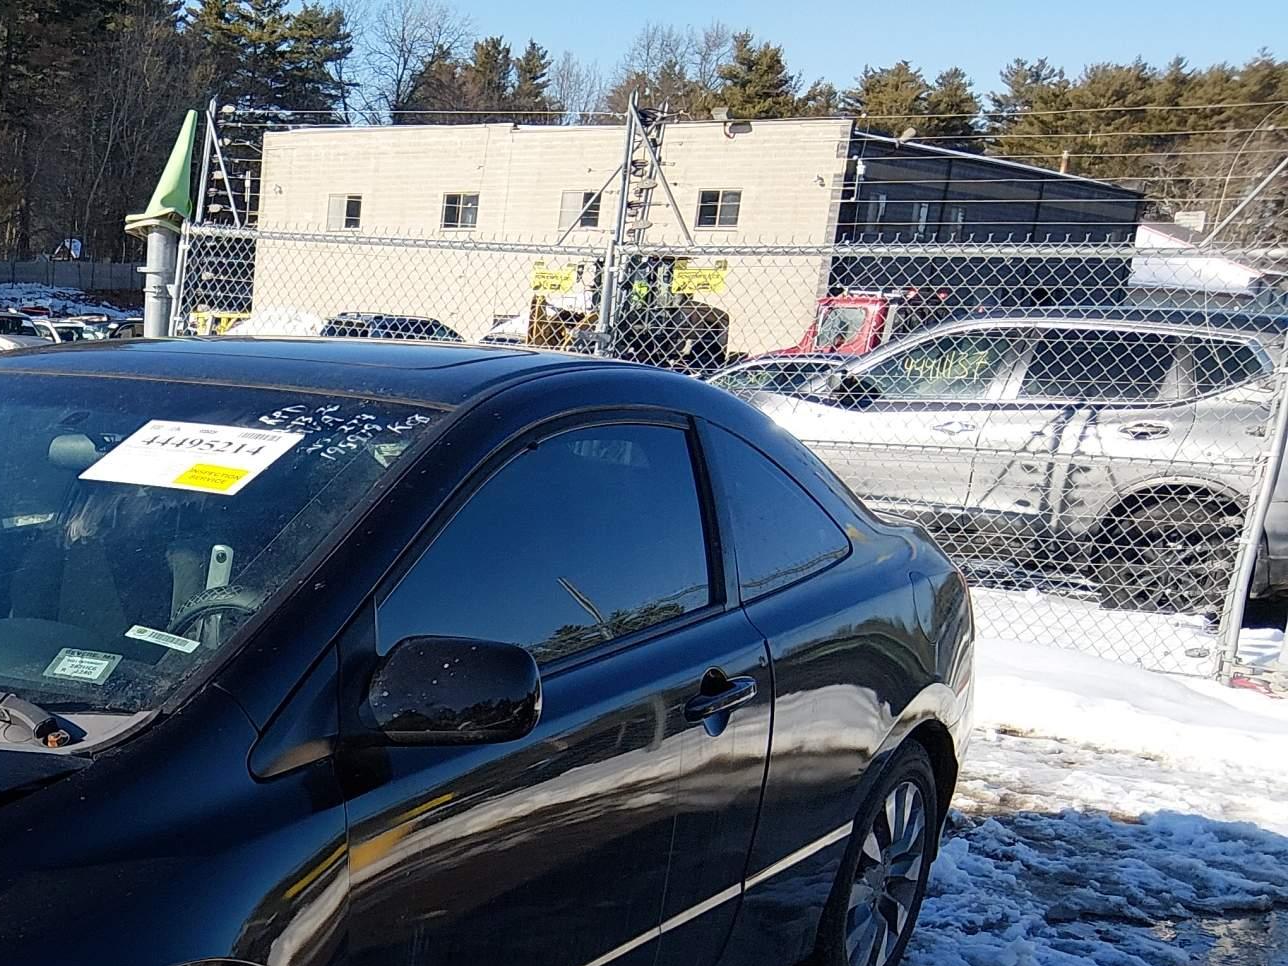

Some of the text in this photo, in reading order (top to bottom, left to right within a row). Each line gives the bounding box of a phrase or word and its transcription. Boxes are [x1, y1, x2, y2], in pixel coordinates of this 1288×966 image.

[141, 435, 266, 456] 44495214
[189, 474, 229, 485] SERVICE
[190, 467, 242, 481] INSPECTION
